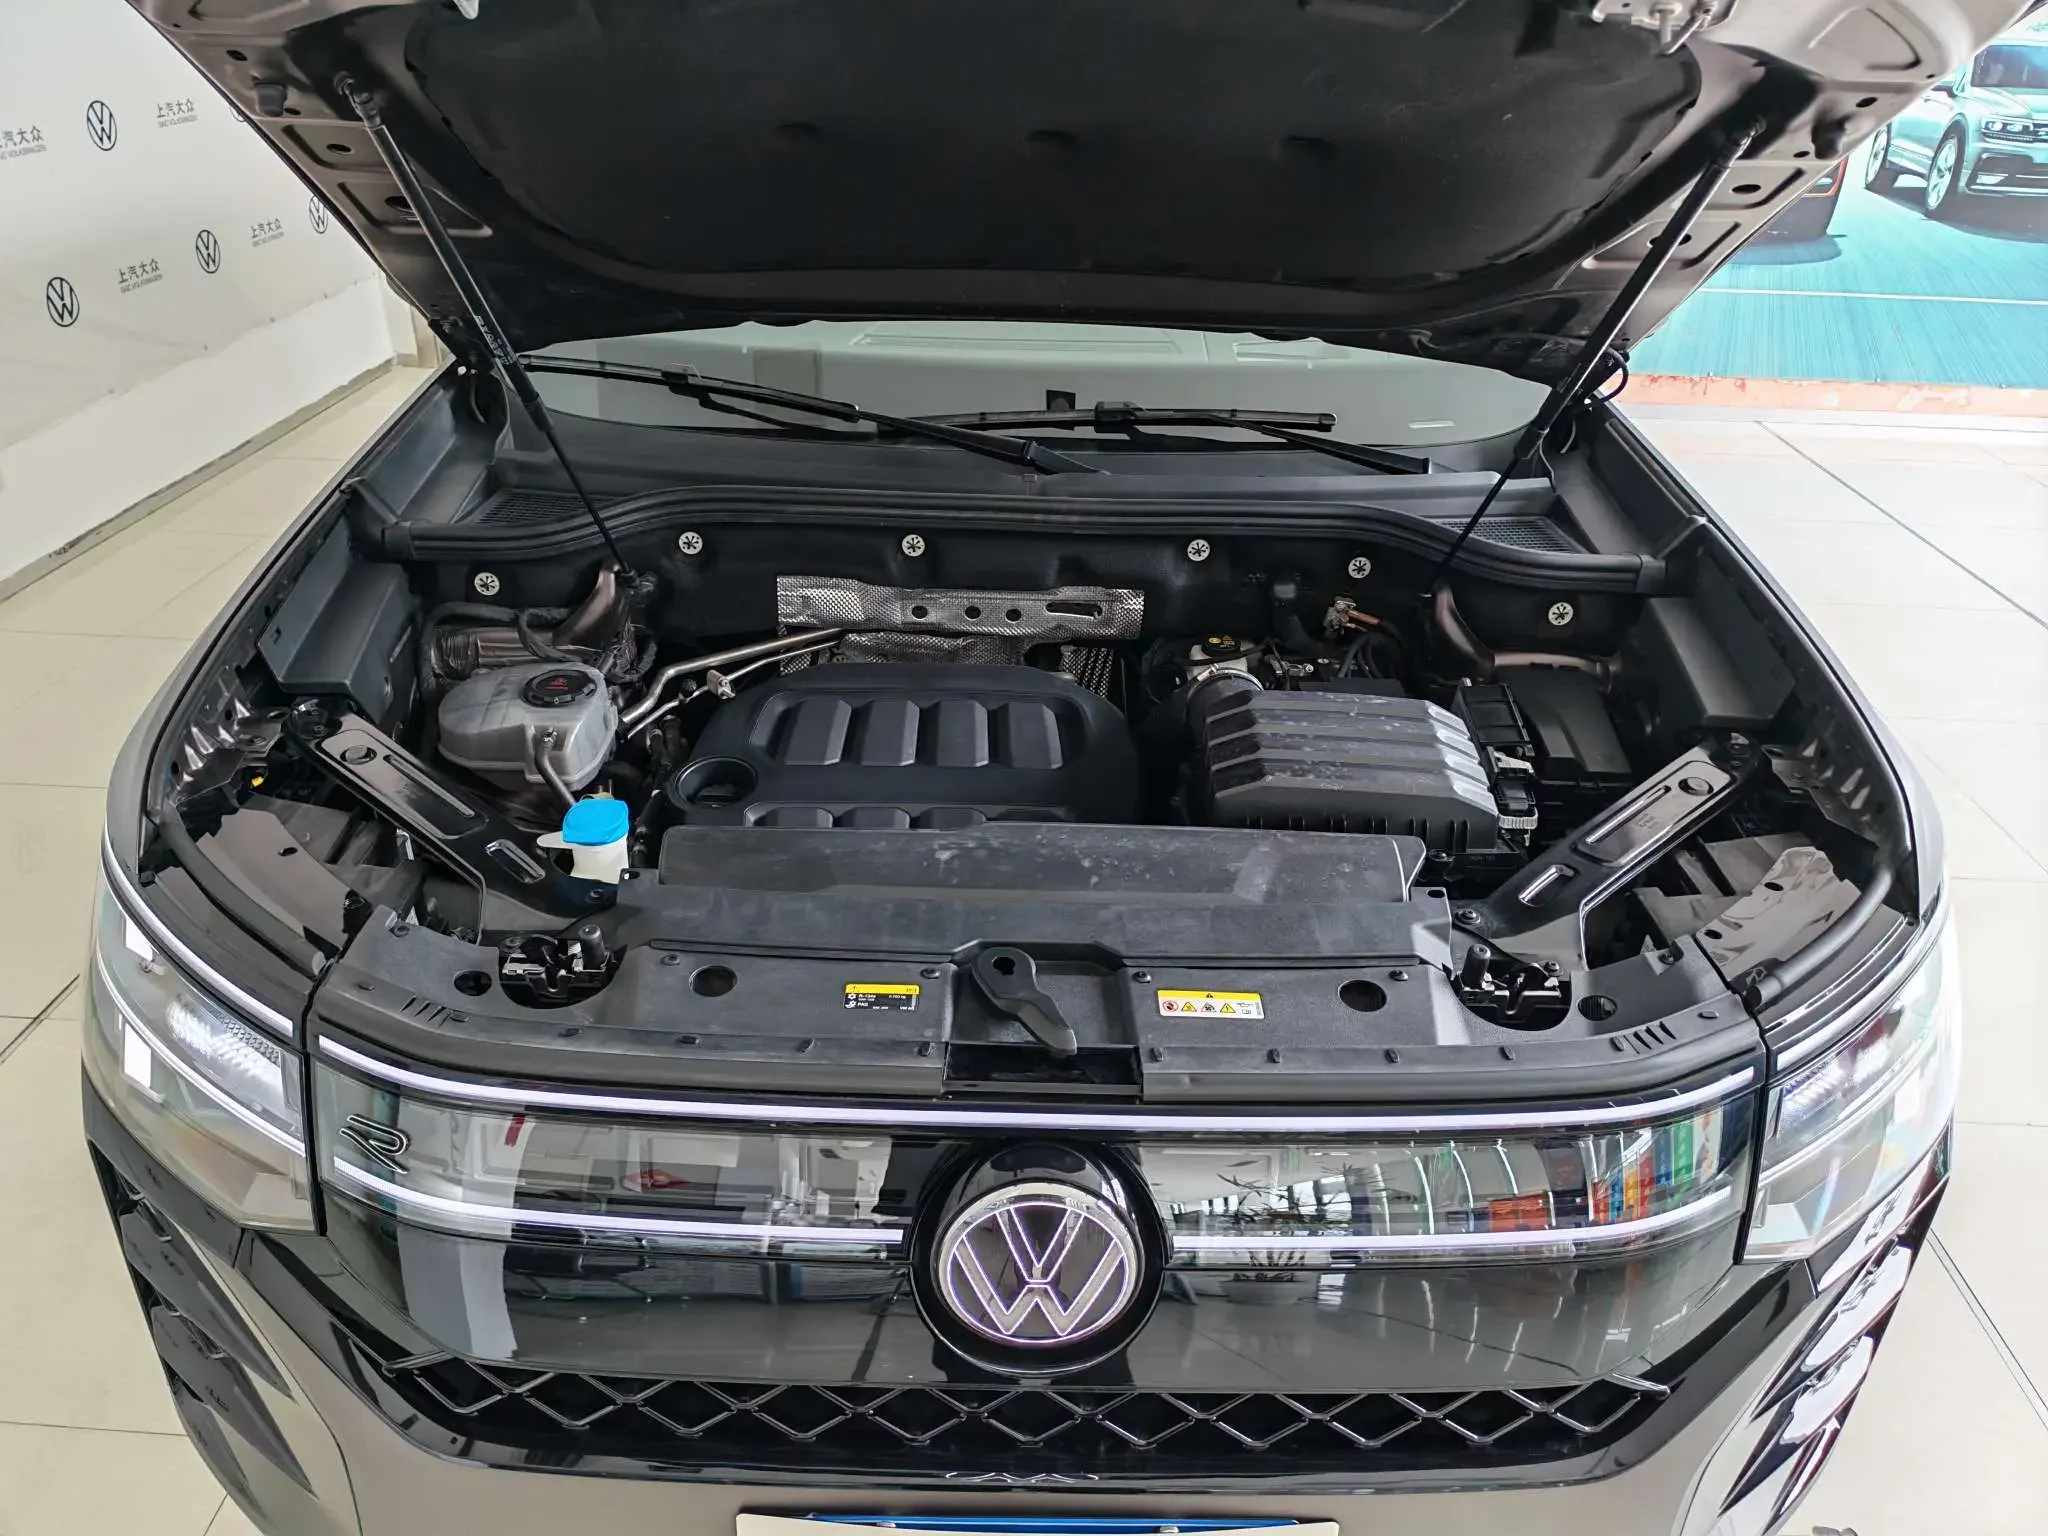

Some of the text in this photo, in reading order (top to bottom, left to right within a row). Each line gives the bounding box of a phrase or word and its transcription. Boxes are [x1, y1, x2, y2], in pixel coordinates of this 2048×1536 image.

[0, 125, 44, 149] 汽大众
[86, 100, 118, 151] VW
[195, 229, 221, 274] VW
[46, 276, 80, 327] VW
[946, 1201, 1130, 1344] VW
